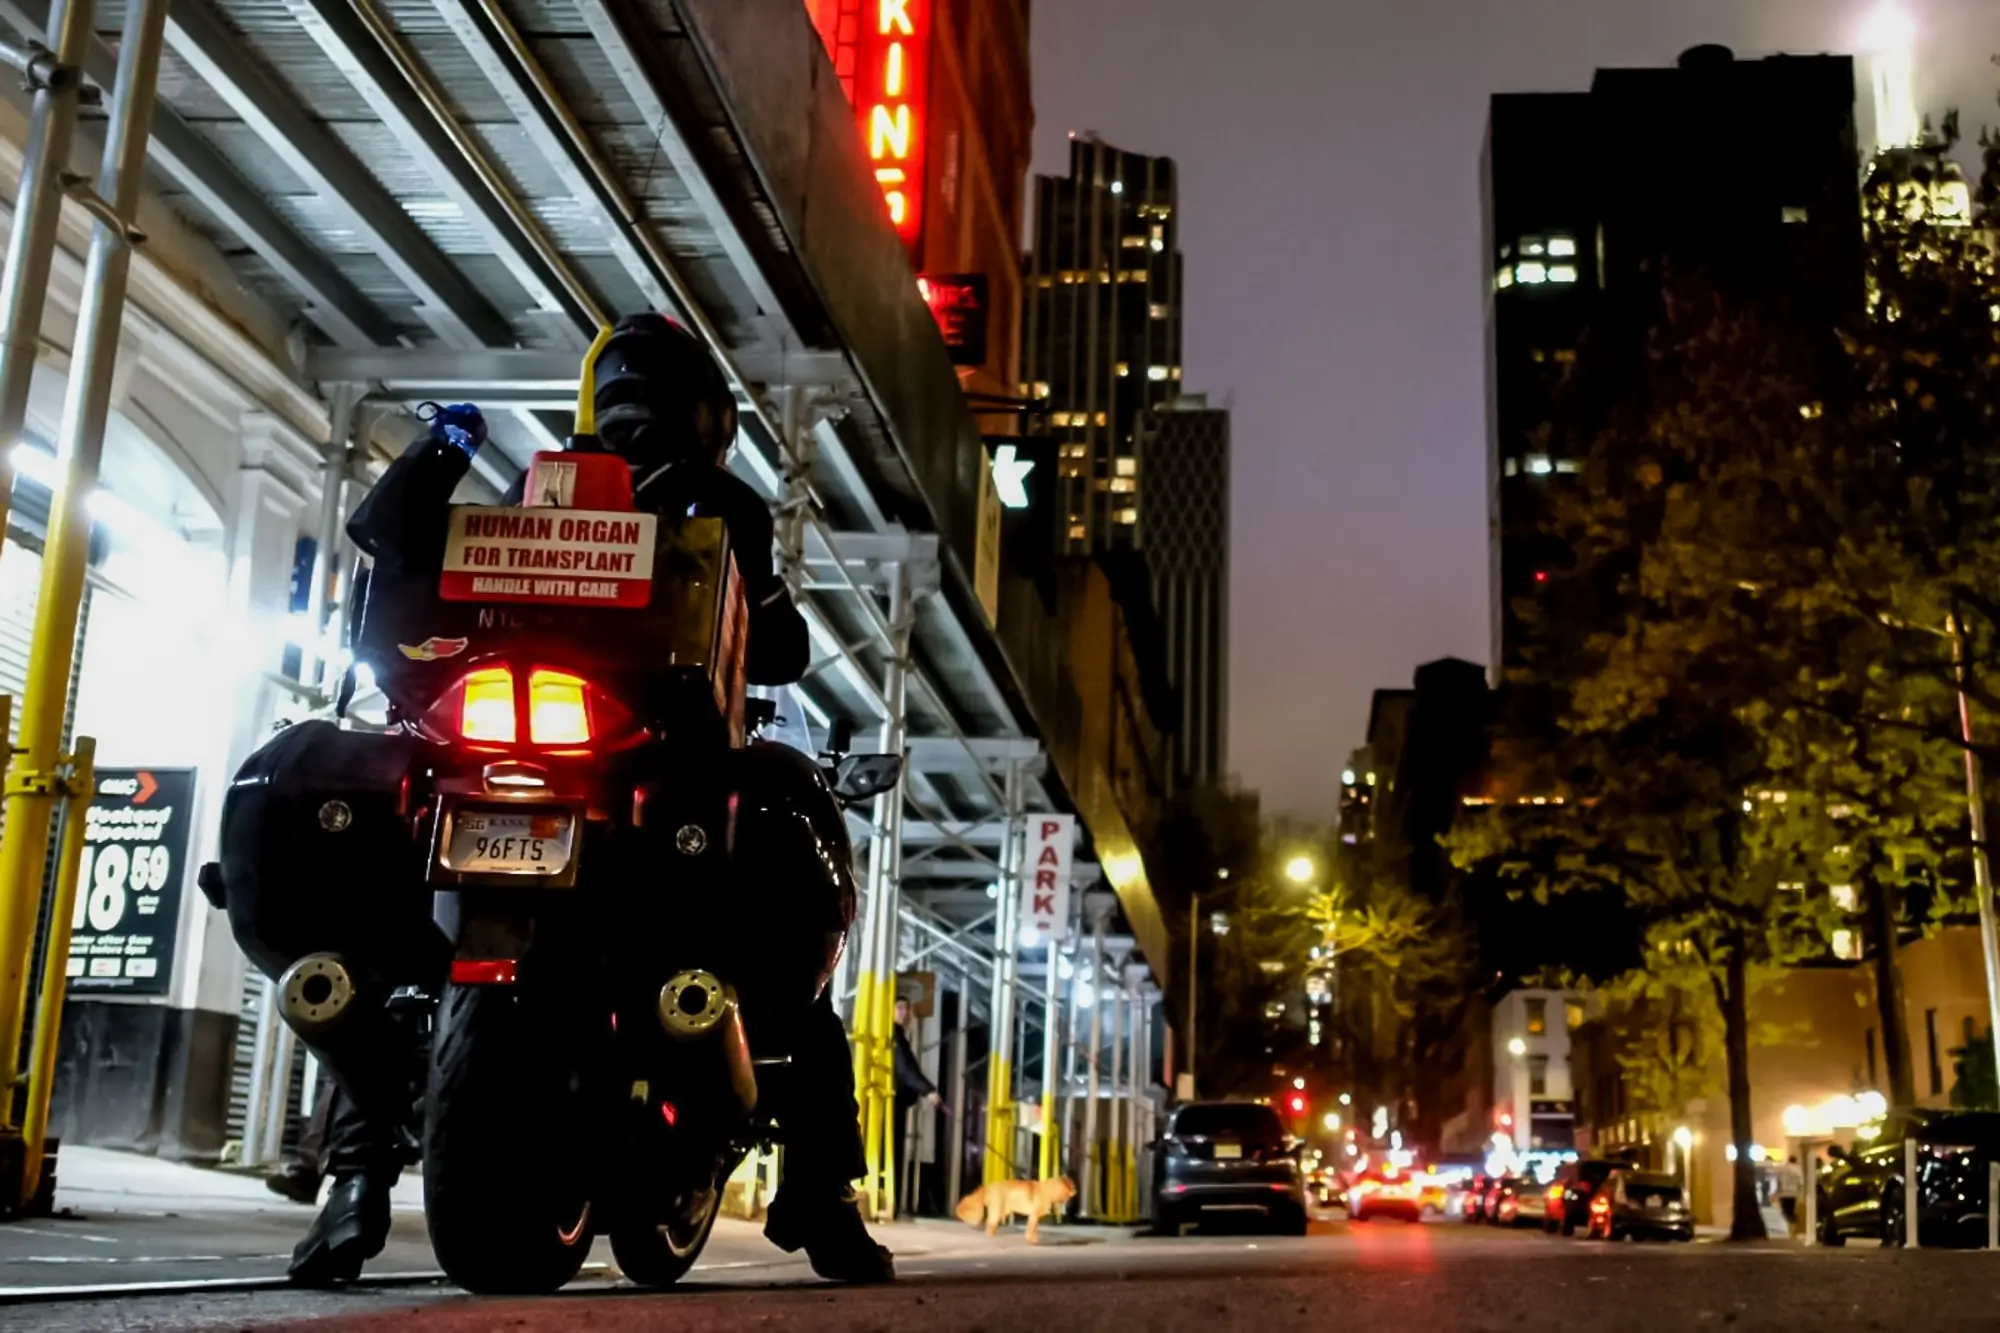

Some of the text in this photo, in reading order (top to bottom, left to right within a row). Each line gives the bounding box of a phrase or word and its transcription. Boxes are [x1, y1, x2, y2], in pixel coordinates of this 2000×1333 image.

[464, 514, 641, 545] HUMAN ORGAN
[463, 546, 636, 573] FOR TRANSPLANT
[472, 577, 619, 599] HANDLE WITH CARE
[476, 837, 544, 861] 96FTS
